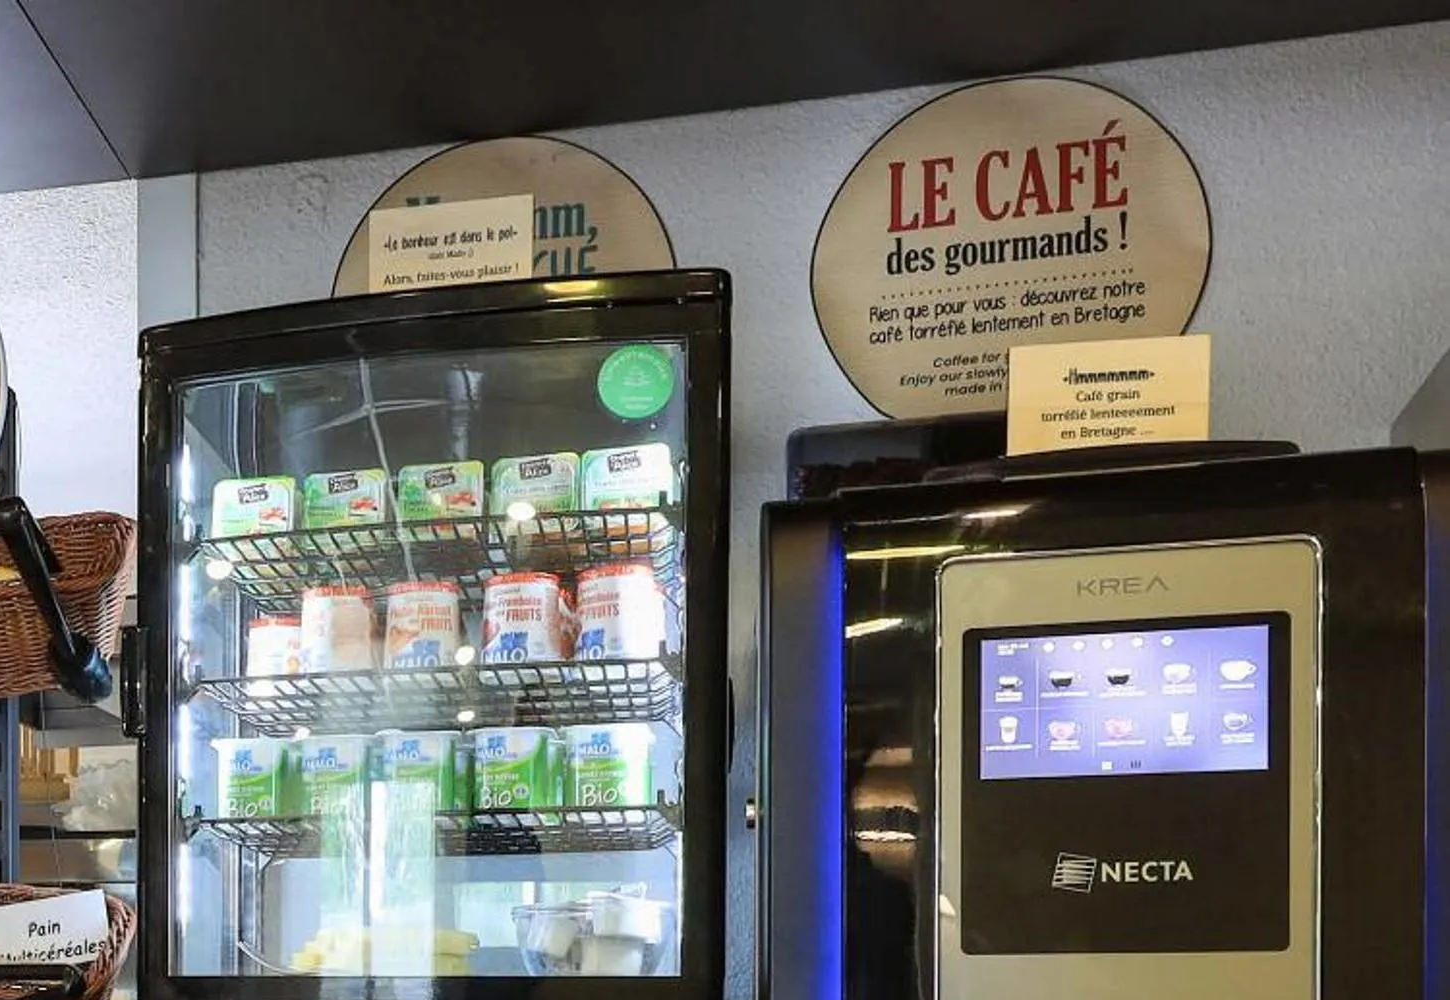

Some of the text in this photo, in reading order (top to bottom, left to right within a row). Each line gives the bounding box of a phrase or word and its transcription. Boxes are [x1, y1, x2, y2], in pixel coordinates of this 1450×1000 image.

[887, 119, 1129, 233] LE CAFÉ
[460, 231, 482, 243] dans
[886, 211, 1129, 275] des gourmands !
[869, 306, 900, 322] Rien
[904, 304, 930, 322] que
[934, 299, 968, 320] pour
[973, 296, 1007, 312] vous
[1020, 285, 1099, 307] découvrez
[1103, 279, 1146, 299] notre
[869, 303, 1147, 345] café torréfié lentement en Bretagne
[932, 352, 1001, 368] Coffee for
[899, 368, 1007, 388] Enjoy our slowly
[944, 380, 1003, 396] made in
[1075, 388, 1141, 403] Café grain
[1041, 409, 1088, 422] torréfié
[1061, 426, 1137, 440] en Bretagne
[1076, 576, 1169, 597] KREA
[506, 606, 542, 622] FRUITS
[582, 783, 619, 807] Bio
[1101, 860, 1194, 882] NECTA
[28, 919, 61, 938] Pain
